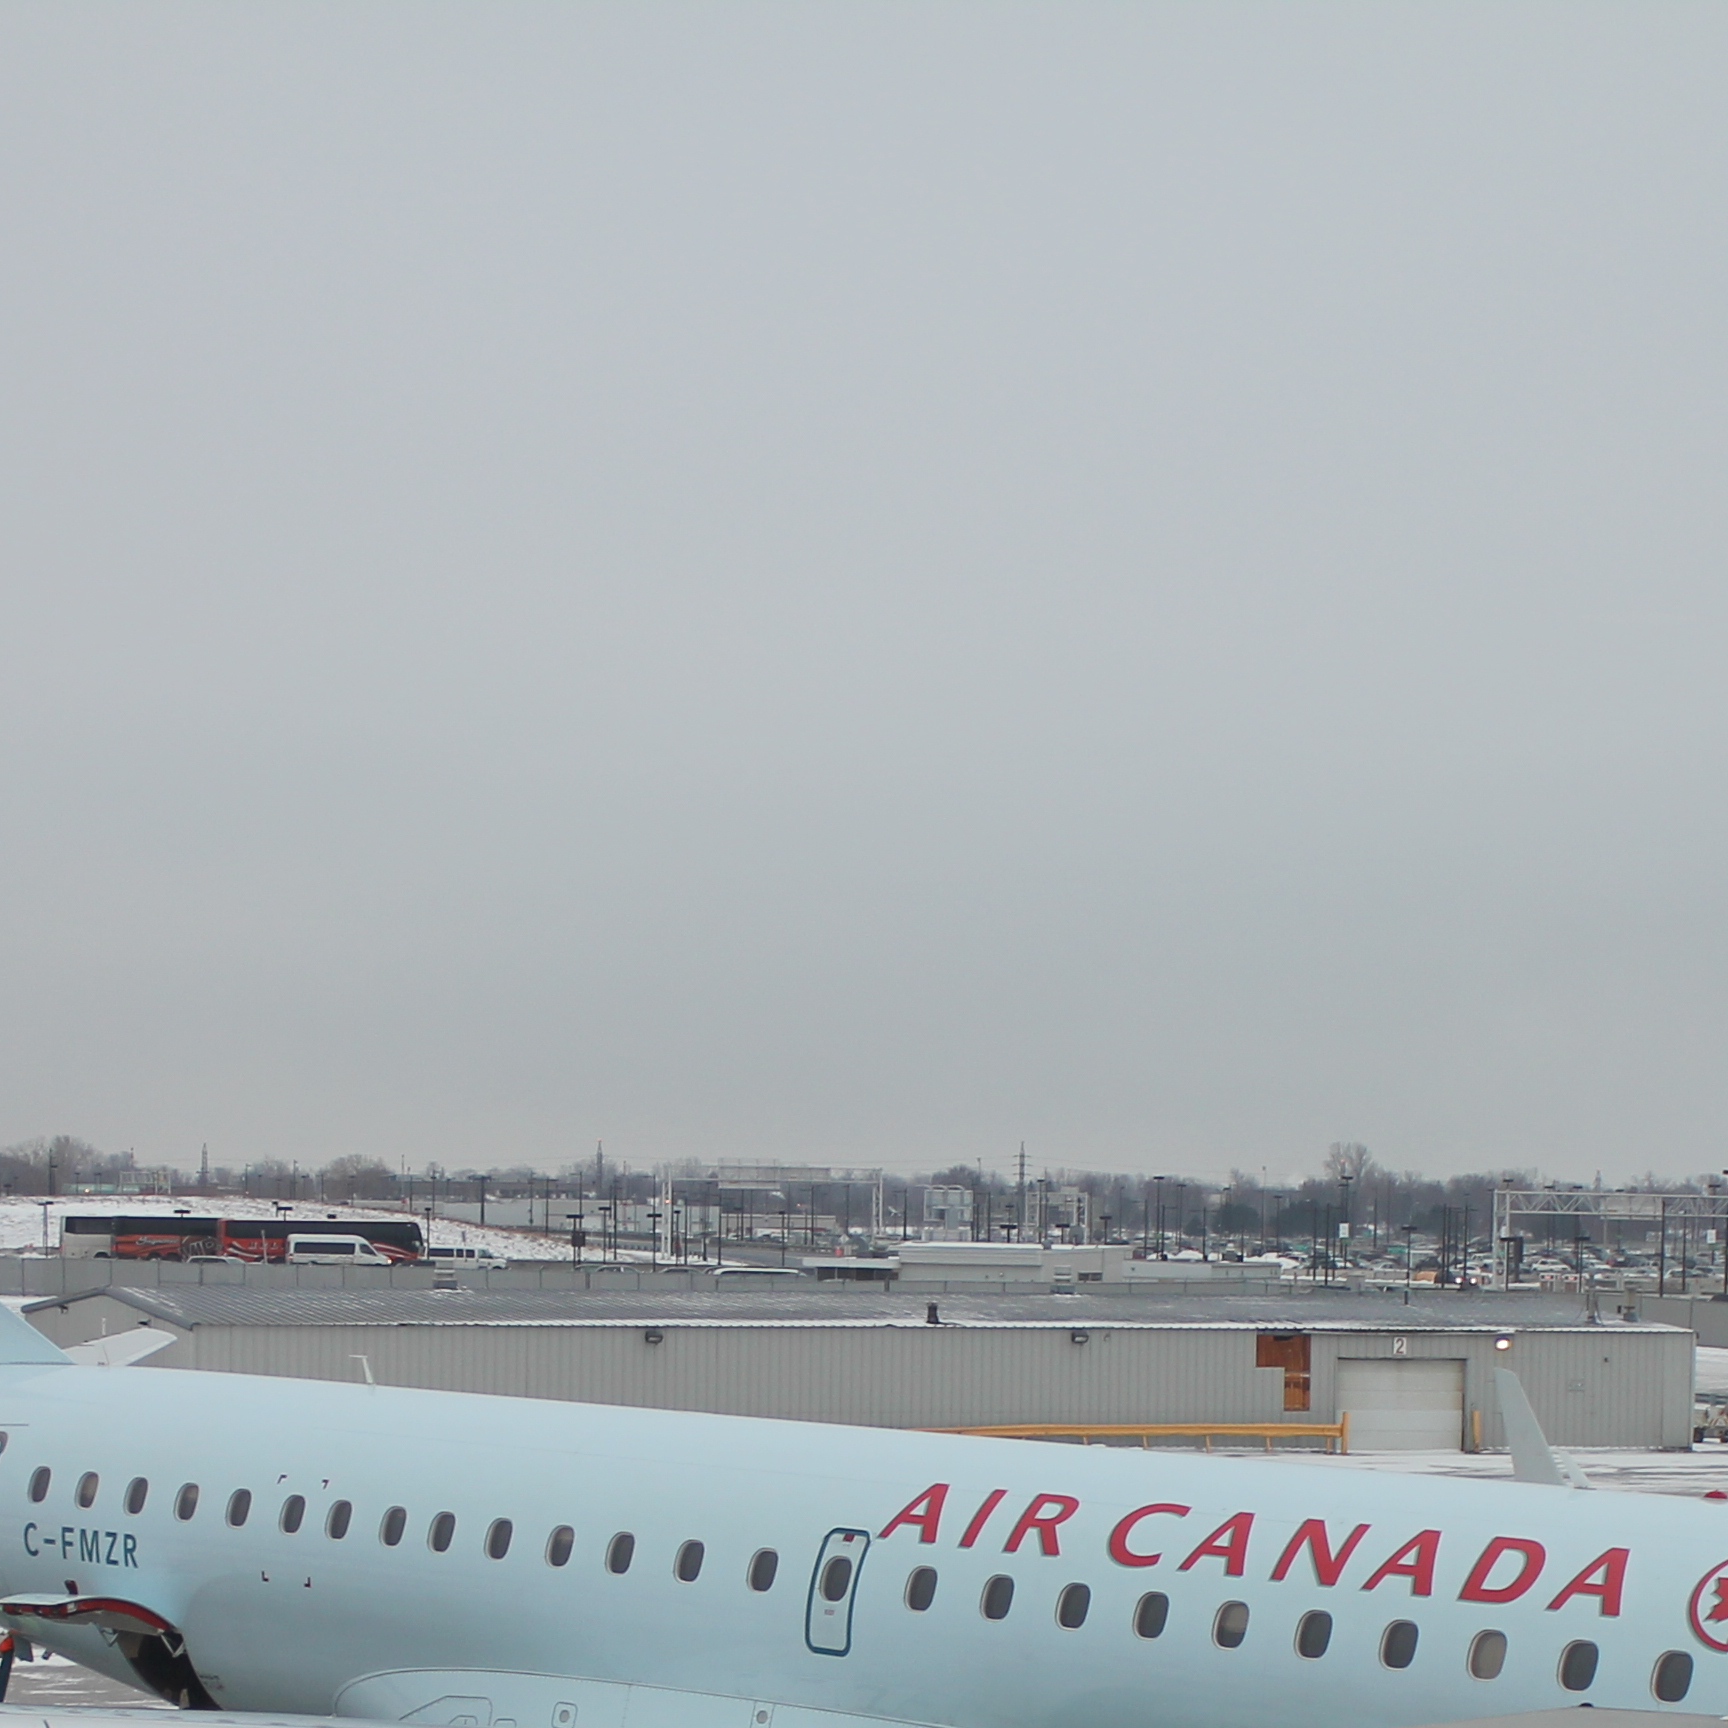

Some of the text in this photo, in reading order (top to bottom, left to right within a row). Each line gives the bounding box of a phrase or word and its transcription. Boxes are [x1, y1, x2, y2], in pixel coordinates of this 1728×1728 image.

[1395, 1337, 1404, 1354] 2
[24, 1521, 139, 1569] C-FMZR
[876, 1482, 1630, 1617] AIR CANADA
